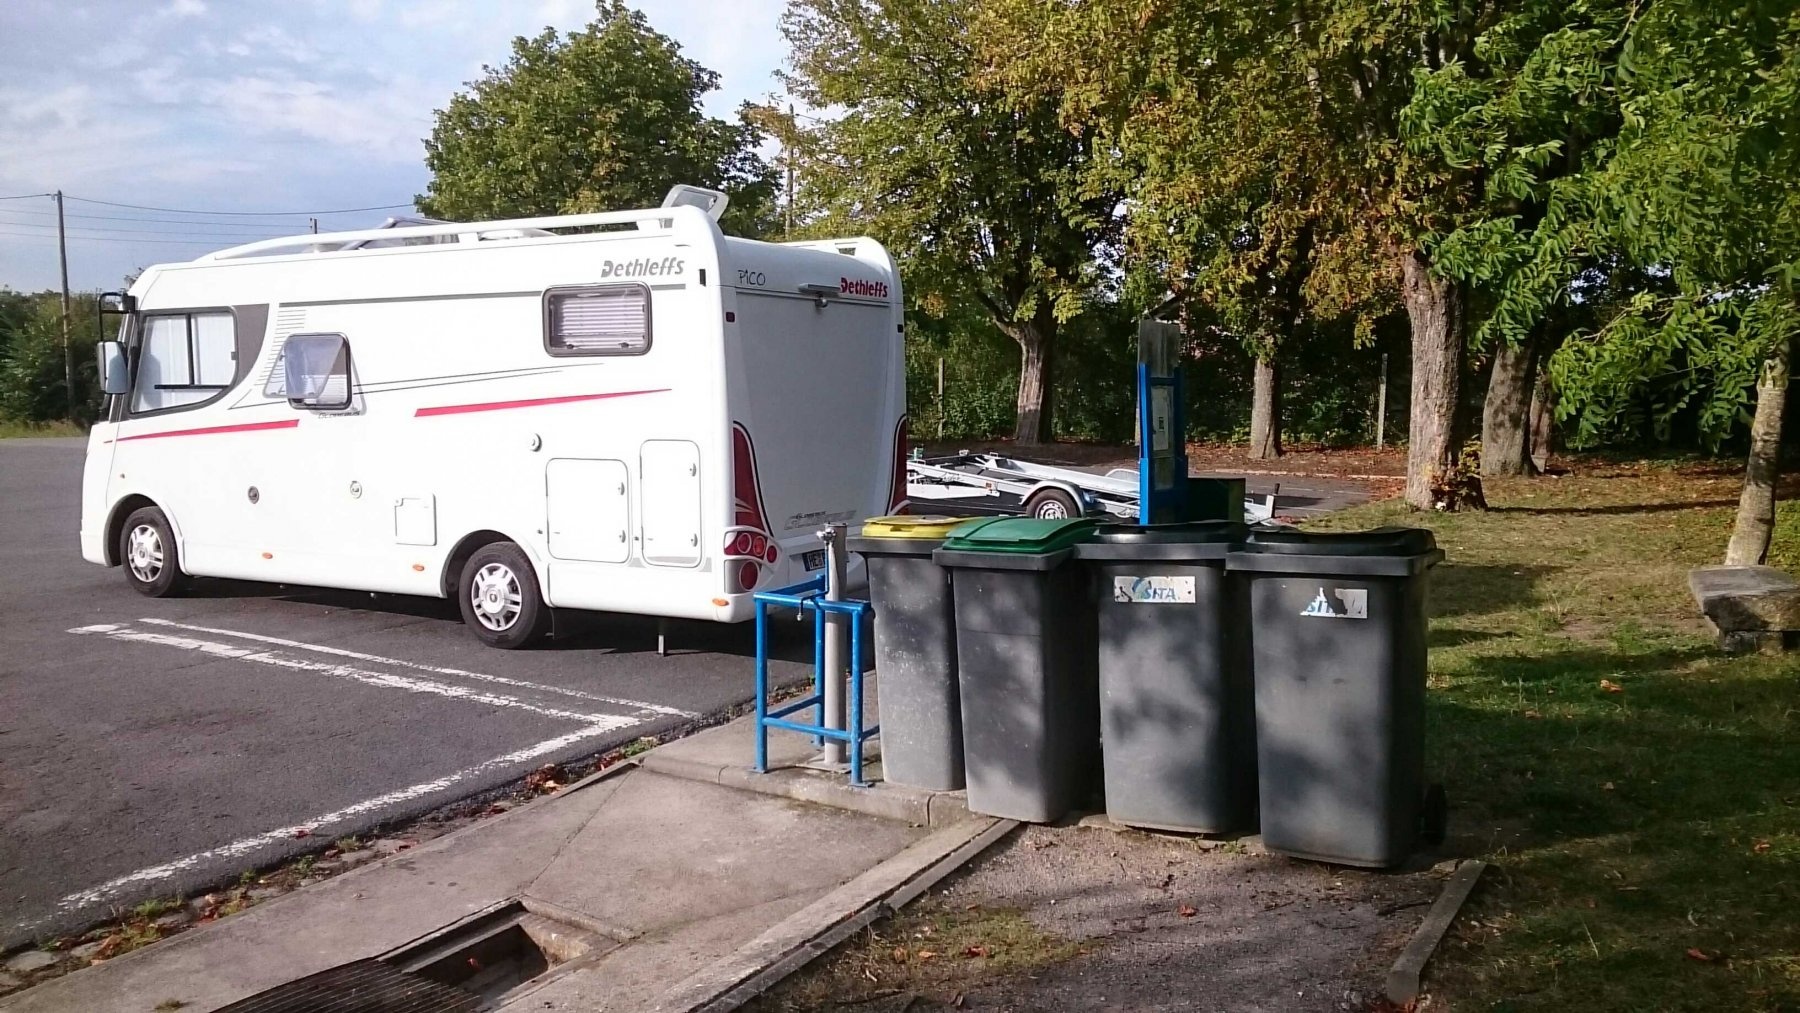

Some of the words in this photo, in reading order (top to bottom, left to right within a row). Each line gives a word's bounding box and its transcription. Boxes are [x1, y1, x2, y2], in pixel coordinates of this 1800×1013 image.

[601, 257, 685, 278] Dethleffs
[737, 269, 766, 286] PICO
[841, 277, 888, 298] Dethleffs
[1143, 587, 1177, 601] SITA
